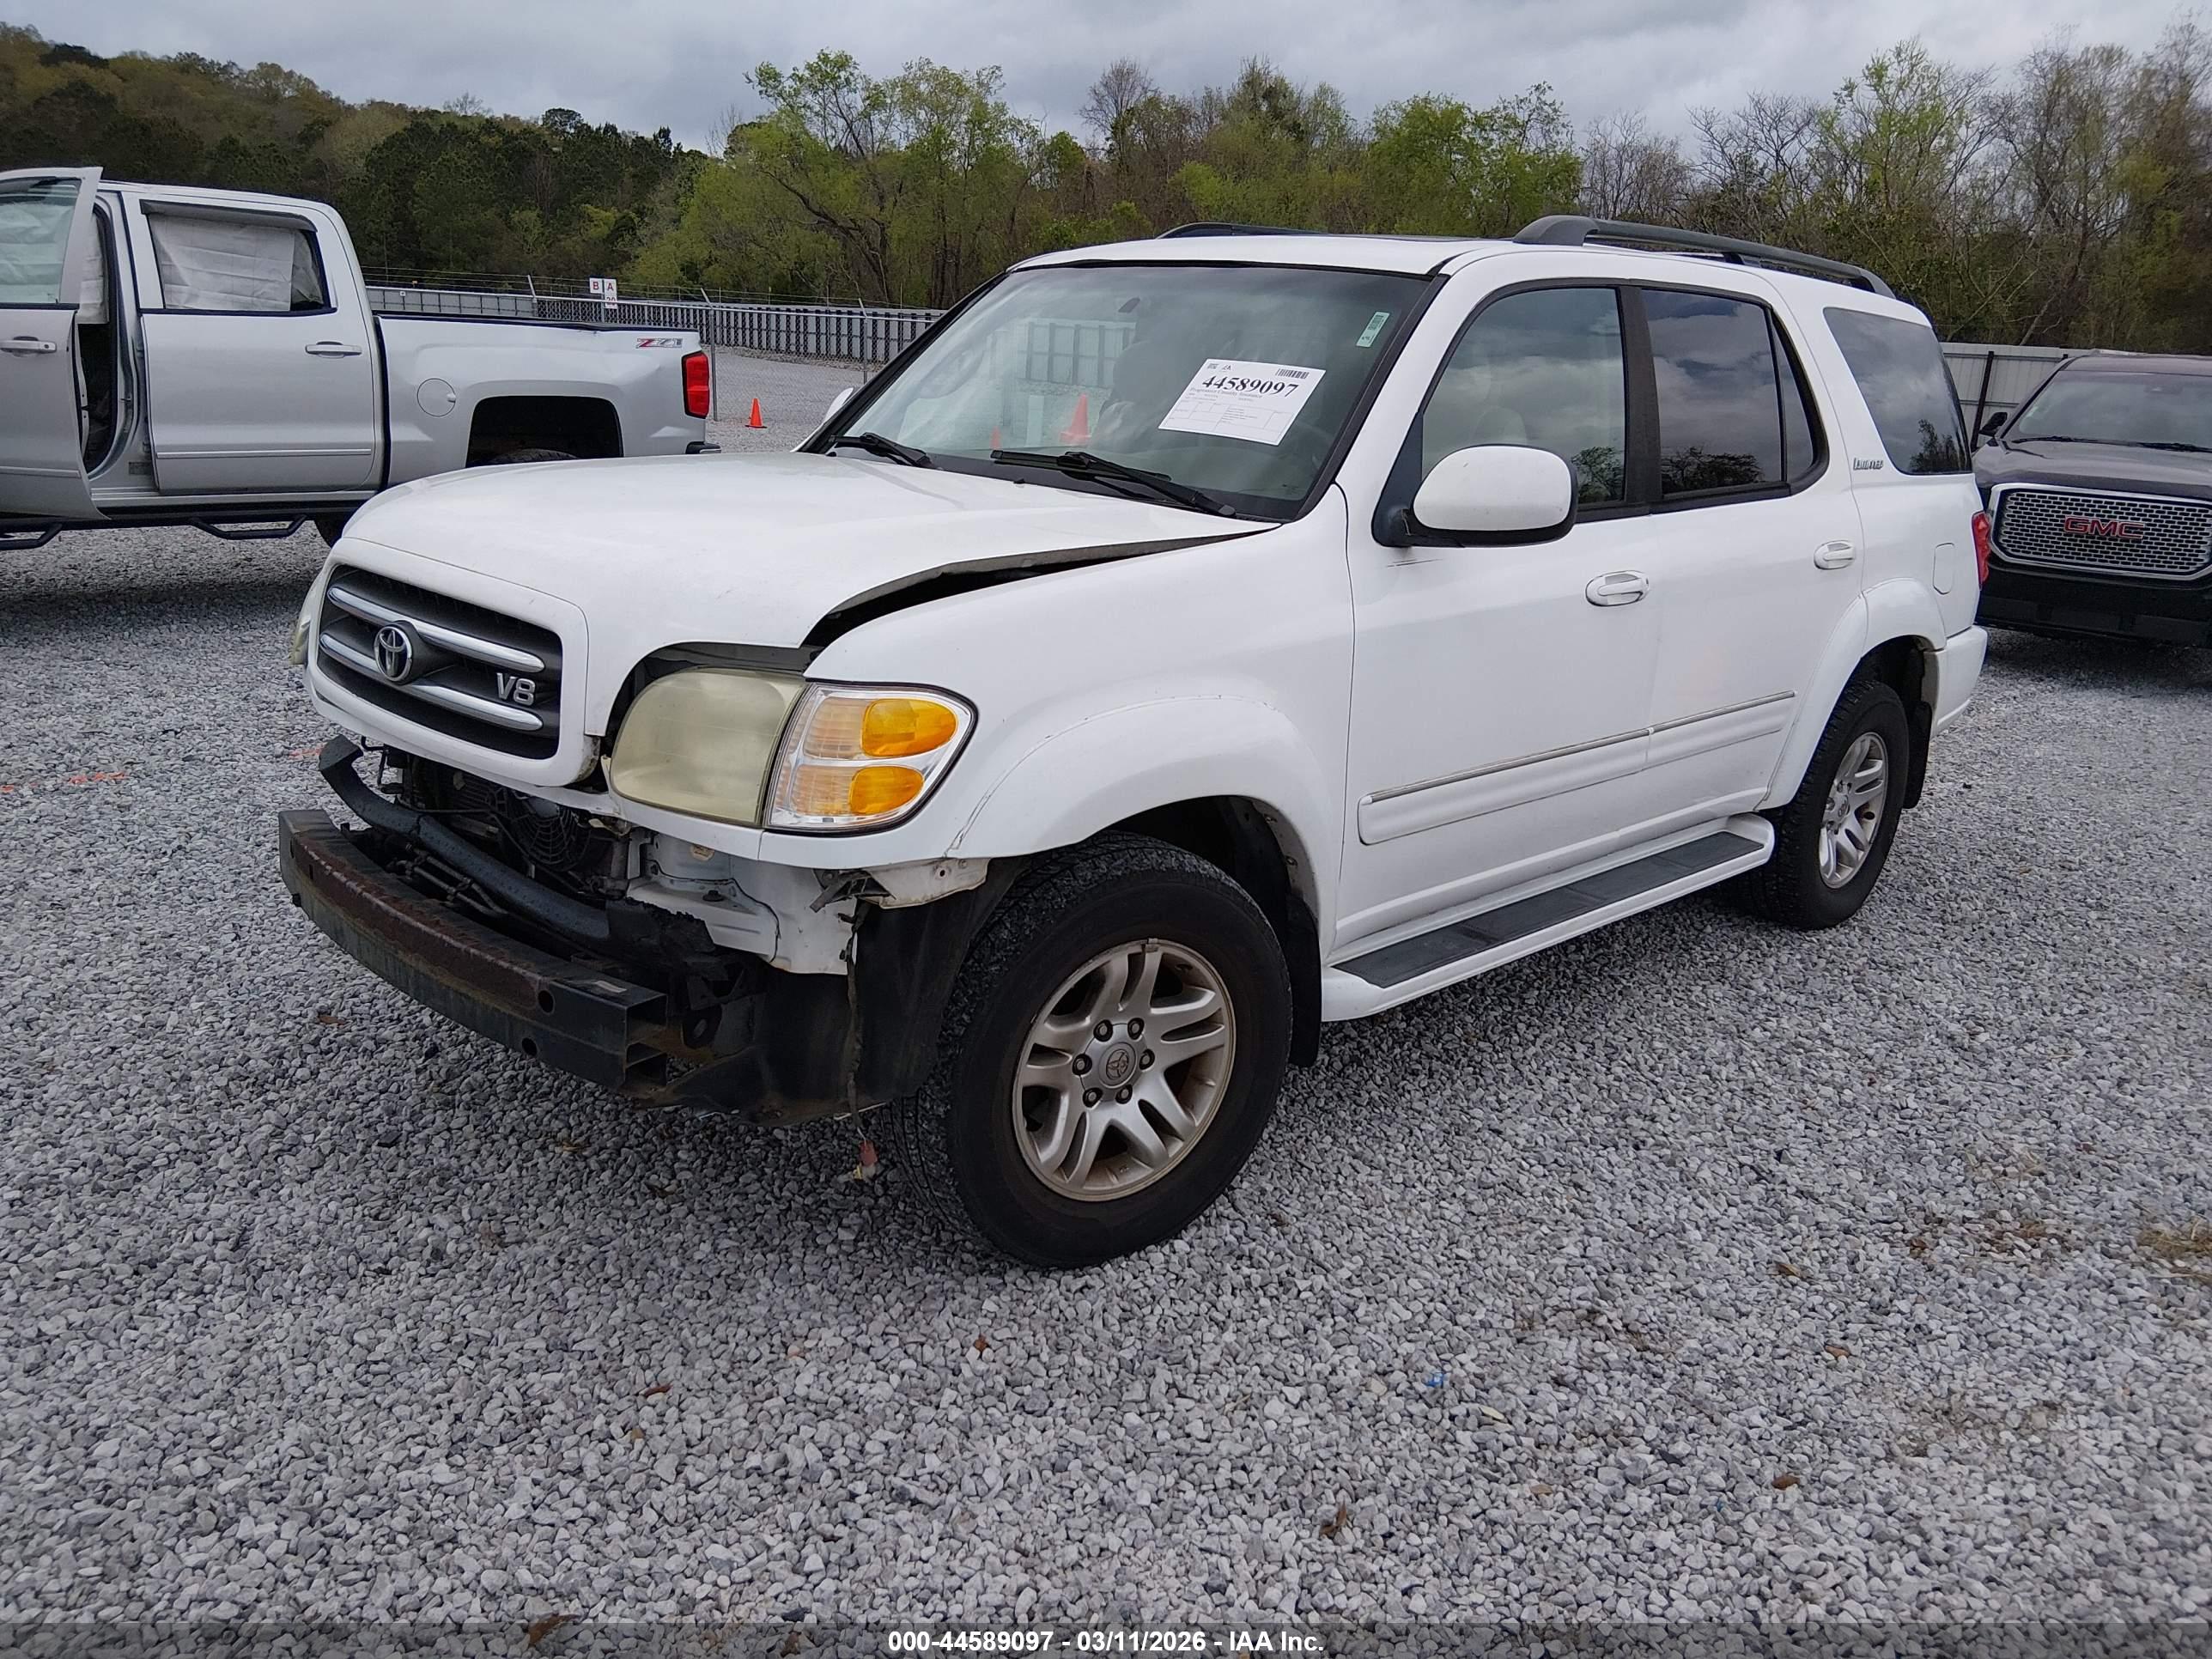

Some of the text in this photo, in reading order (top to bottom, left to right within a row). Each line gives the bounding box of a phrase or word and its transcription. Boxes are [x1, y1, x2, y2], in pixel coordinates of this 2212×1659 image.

[592, 282, 599, 290] B
[607, 283, 614, 291] A
[636, 337, 684, 349] Z71
[1202, 375, 1299, 398] 44589097
[2064, 515, 2145, 539] GMC
[497, 672, 536, 706] V8
